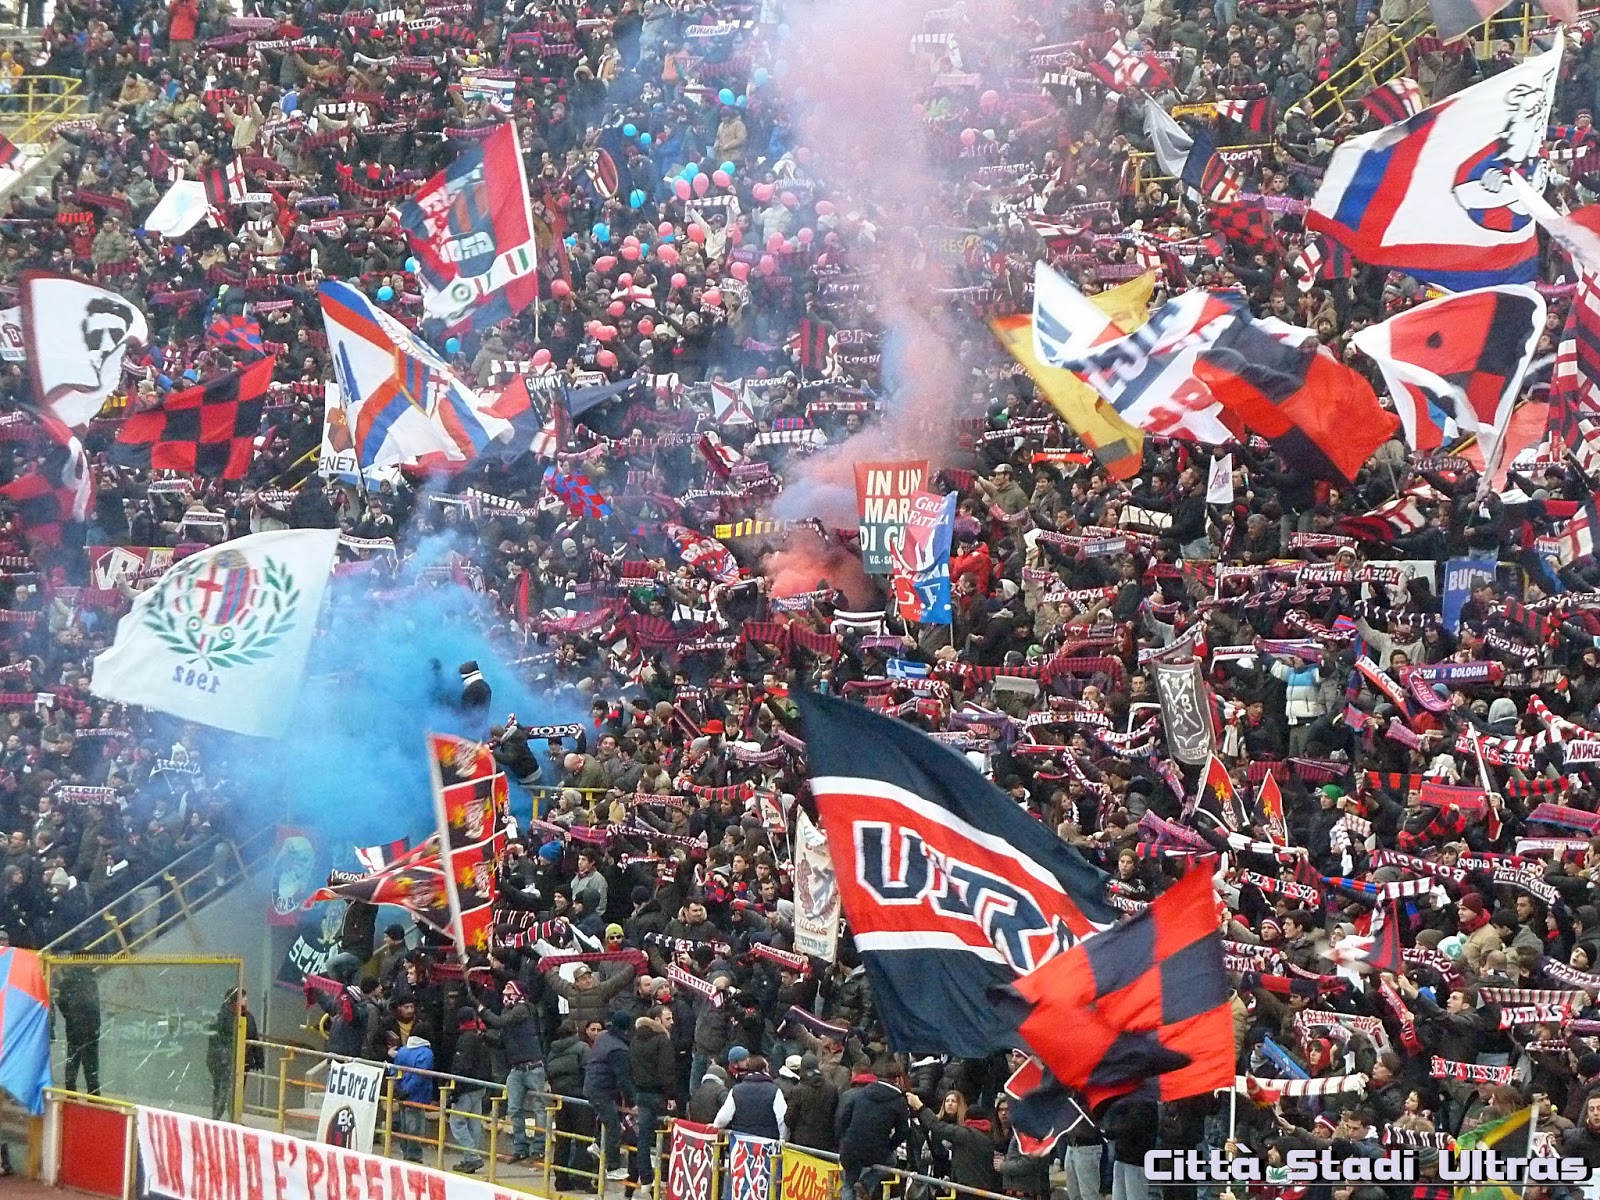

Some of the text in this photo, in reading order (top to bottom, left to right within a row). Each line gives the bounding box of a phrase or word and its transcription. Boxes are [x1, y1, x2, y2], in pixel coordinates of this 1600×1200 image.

[525, 375, 563, 391] GIMMY
[866, 469, 922, 496] IN UN
[865, 498, 911, 523] MAR
[859, 525, 876, 551] DI
[1043, 588, 1104, 603] BOLOGNA
[1450, 665, 1488, 678] BOLOGNA
[1482, 743, 1536, 769] TESSERA
[634, 792, 684, 808] BOLOGNA
[1502, 1003, 1565, 1024] ULTRAS
[328, 1066, 368, 1101] ttore
[1466, 1062, 1514, 1085] TESSERA
[147, 1111, 185, 1198] UN
[190, 1120, 263, 1200] ANNO
[687, 1147, 702, 1169] 74
[750, 1154, 763, 1171] 74
